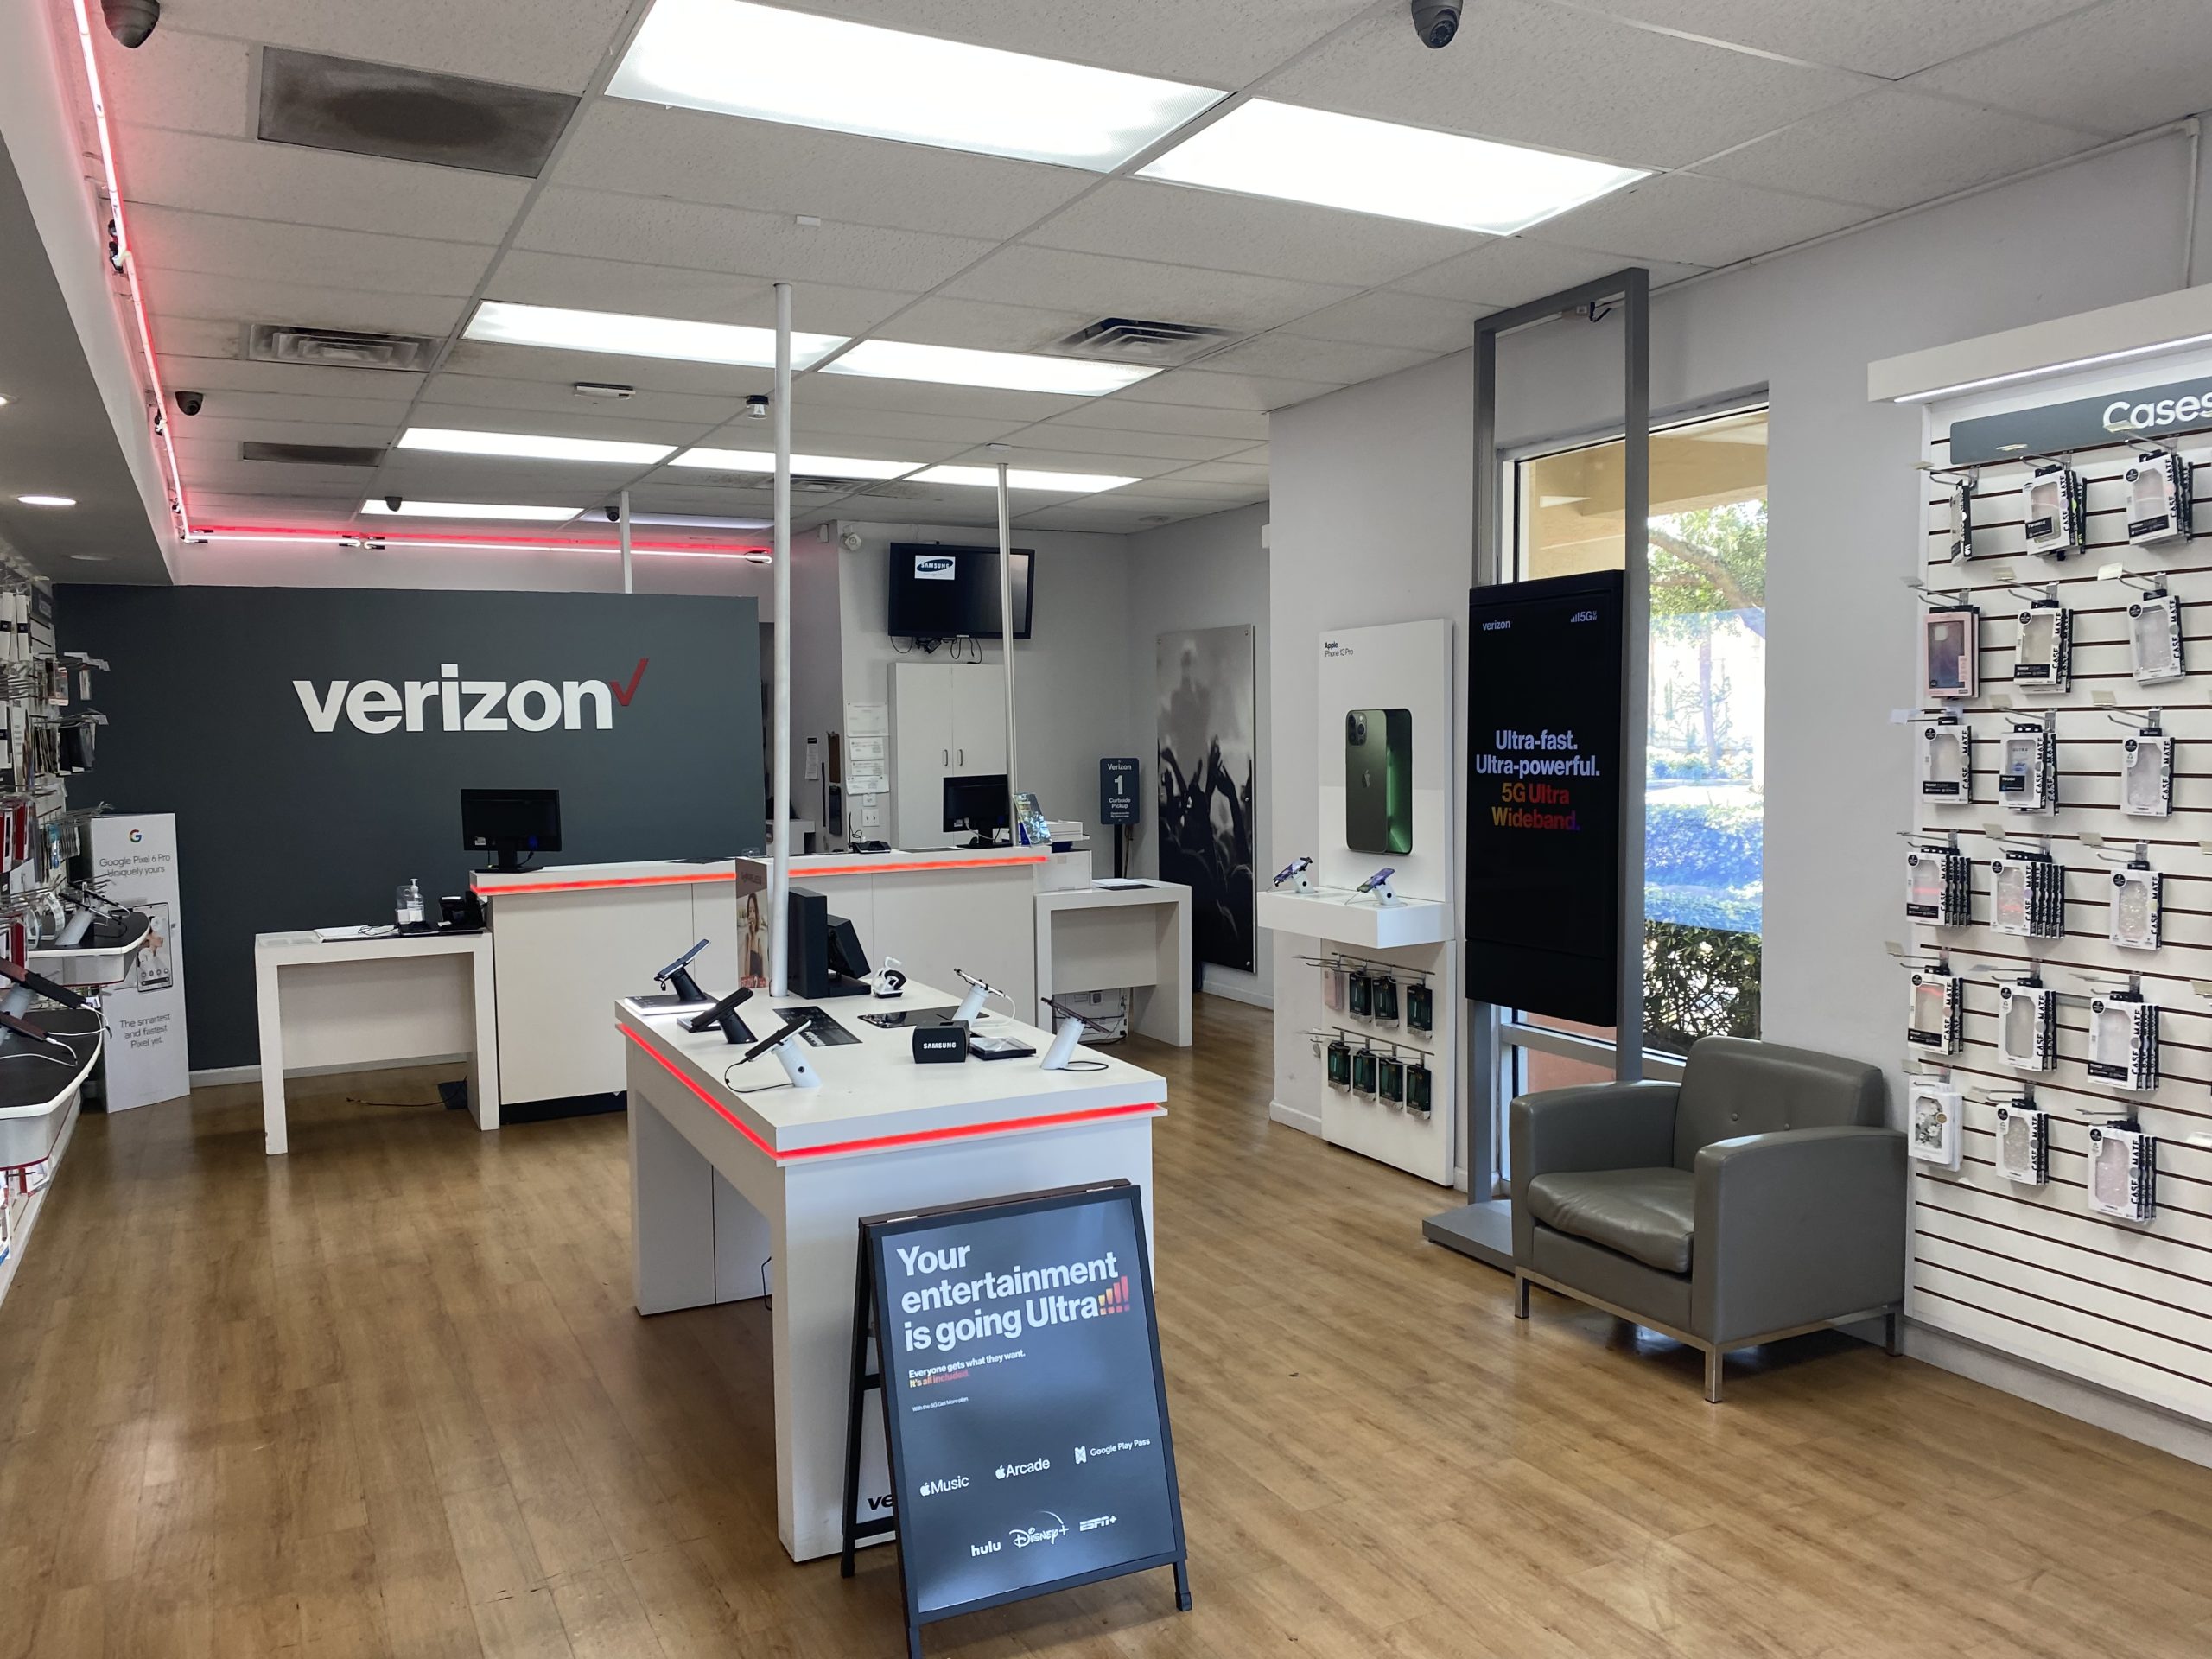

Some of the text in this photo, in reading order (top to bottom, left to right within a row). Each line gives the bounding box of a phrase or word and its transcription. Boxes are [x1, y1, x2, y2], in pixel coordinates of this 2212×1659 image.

[2103, 391, 2212, 429] Cases
[1482, 620, 1510, 631] verizon
[292, 663, 613, 734] verizon
[1496, 729, 1578, 750] Ultra-fast.
[1476, 754, 1600, 779] Ultra-powerful.
[1115, 775, 1122, 795] 1
[1502, 782, 1570, 804] 5G Ultra
[1491, 806, 1580, 830] Wideband.
[99, 857, 131, 868] Google
[133, 854, 149, 864] Pixel
[158, 853, 171, 861] Pro
[107, 866, 165, 877] Uniquely yours
[120, 1014, 170, 1028] The smartest
[124, 1025, 168, 1039] and fastest
[130, 1039, 149, 1048] Pixel
[897, 1244, 971, 1277] Your
[901, 1251, 1119, 1314] entertainment
[904, 1322, 931, 1351] is
[936, 1308, 1022, 1351] going
[908, 1349, 1026, 1379] Everyone gets what they want.
[910, 1379, 922, 1388] It's
[922, 1376, 933, 1385] all
[1090, 1439, 1151, 1457] Google Play Pass
[1006, 1458, 1051, 1478] Arcade
[931, 1475, 969, 1495] Music
[970, 1541, 1001, 1557] hulu
[1079, 1515, 1117, 1532] ESPN+
